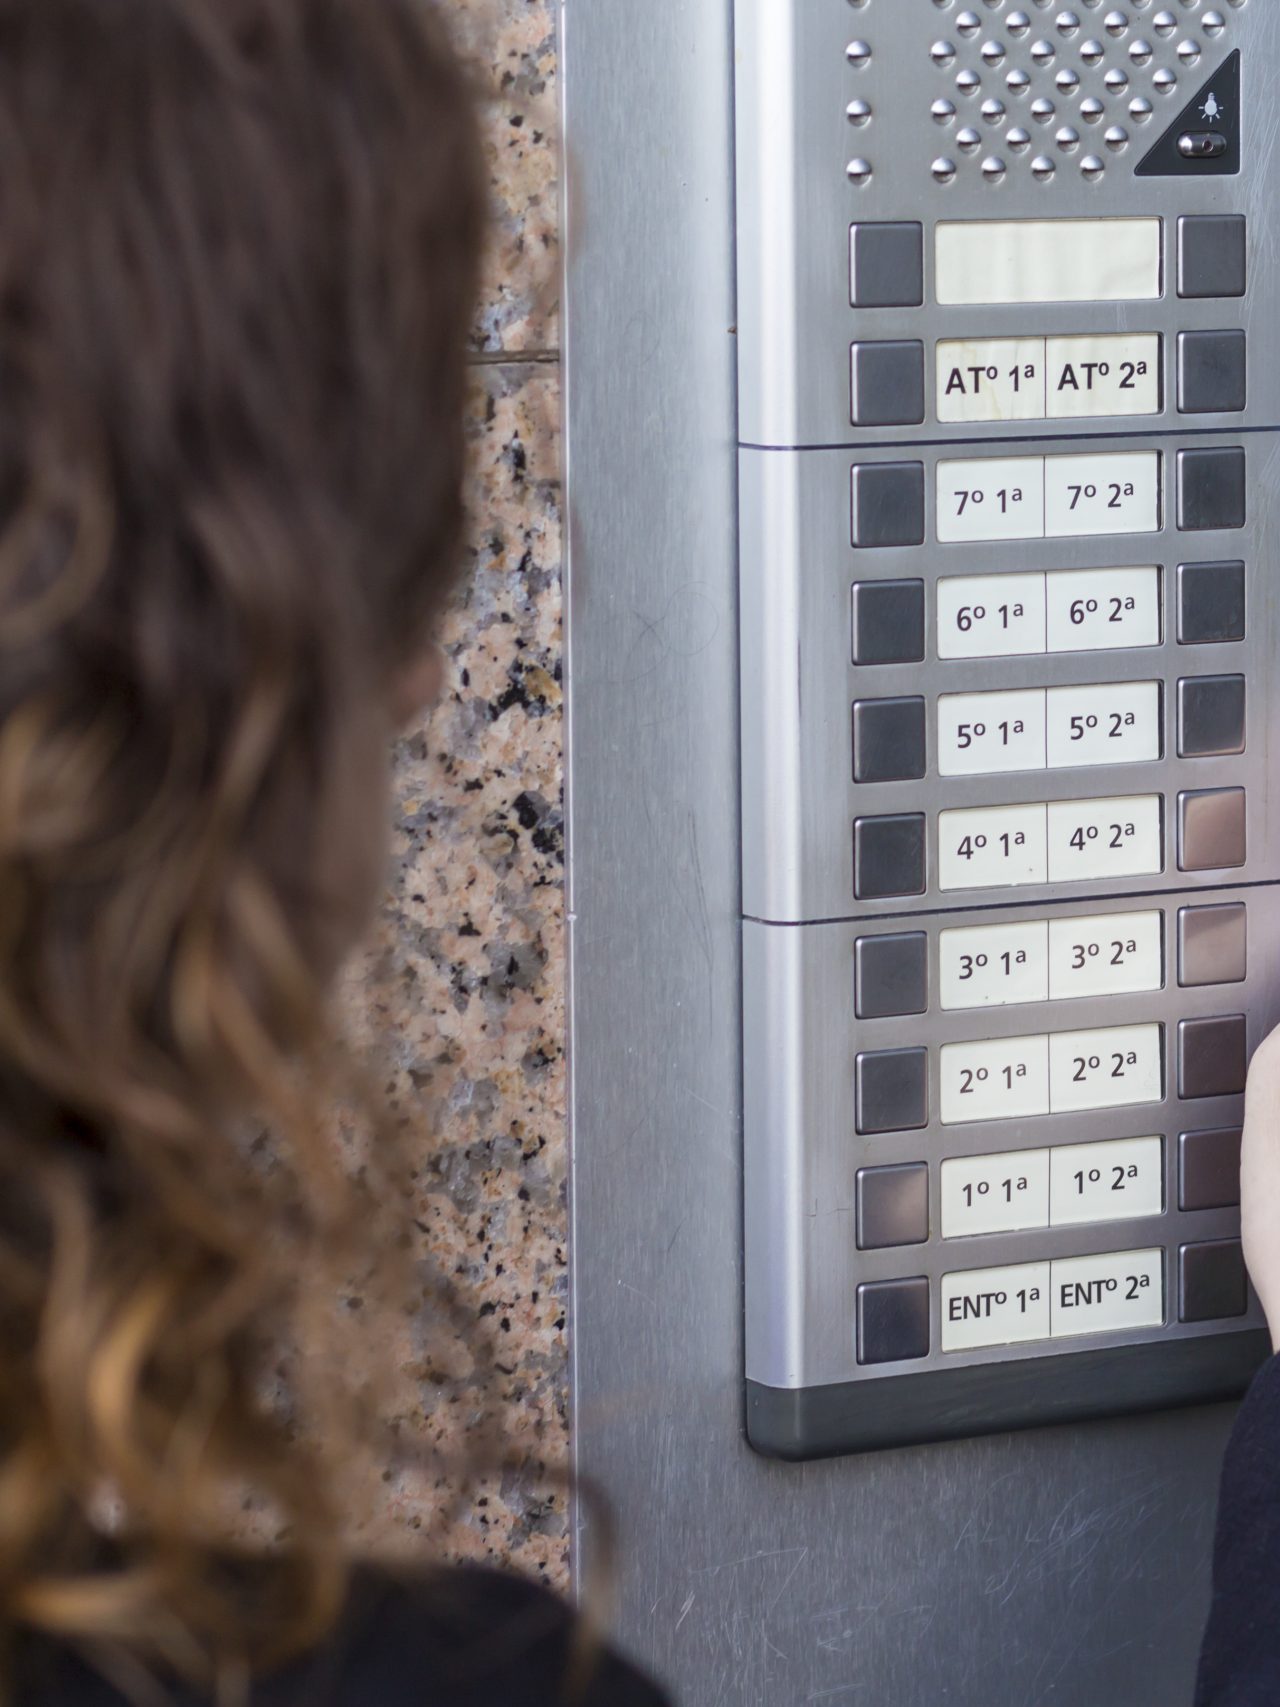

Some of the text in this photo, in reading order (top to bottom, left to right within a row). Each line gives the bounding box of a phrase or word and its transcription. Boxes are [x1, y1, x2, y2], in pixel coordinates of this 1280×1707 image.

[1008, 364, 1035, 393] 1ª
[1118, 360, 1148, 389] 2ª
[953, 487, 1023, 516] 7º 1ª
[1067, 482, 1134, 510] 7º 2ª
[956, 603, 1024, 632] 6º 1ª
[1069, 596, 1136, 625] 6º 2ª
[957, 719, 1024, 749] 5º 1ª
[1070, 712, 1135, 741] 5º 2ª
[956, 831, 1026, 861] 4º 1ª
[1069, 822, 1135, 852] 4º 2ª
[958, 949, 1027, 980] 3º 1ª
[1071, 939, 1137, 970] 3º 2ª
[959, 1063, 1027, 1094] 2º 1ª
[1072, 1051, 1137, 1082] 2º 2ª
[962, 1176, 1028, 1207] 1º 1ª
[1073, 1164, 1138, 1195] 1º 2ª
[1015, 1287, 1040, 1313] 1ª
[1124, 1273, 1150, 1301] 2ª
